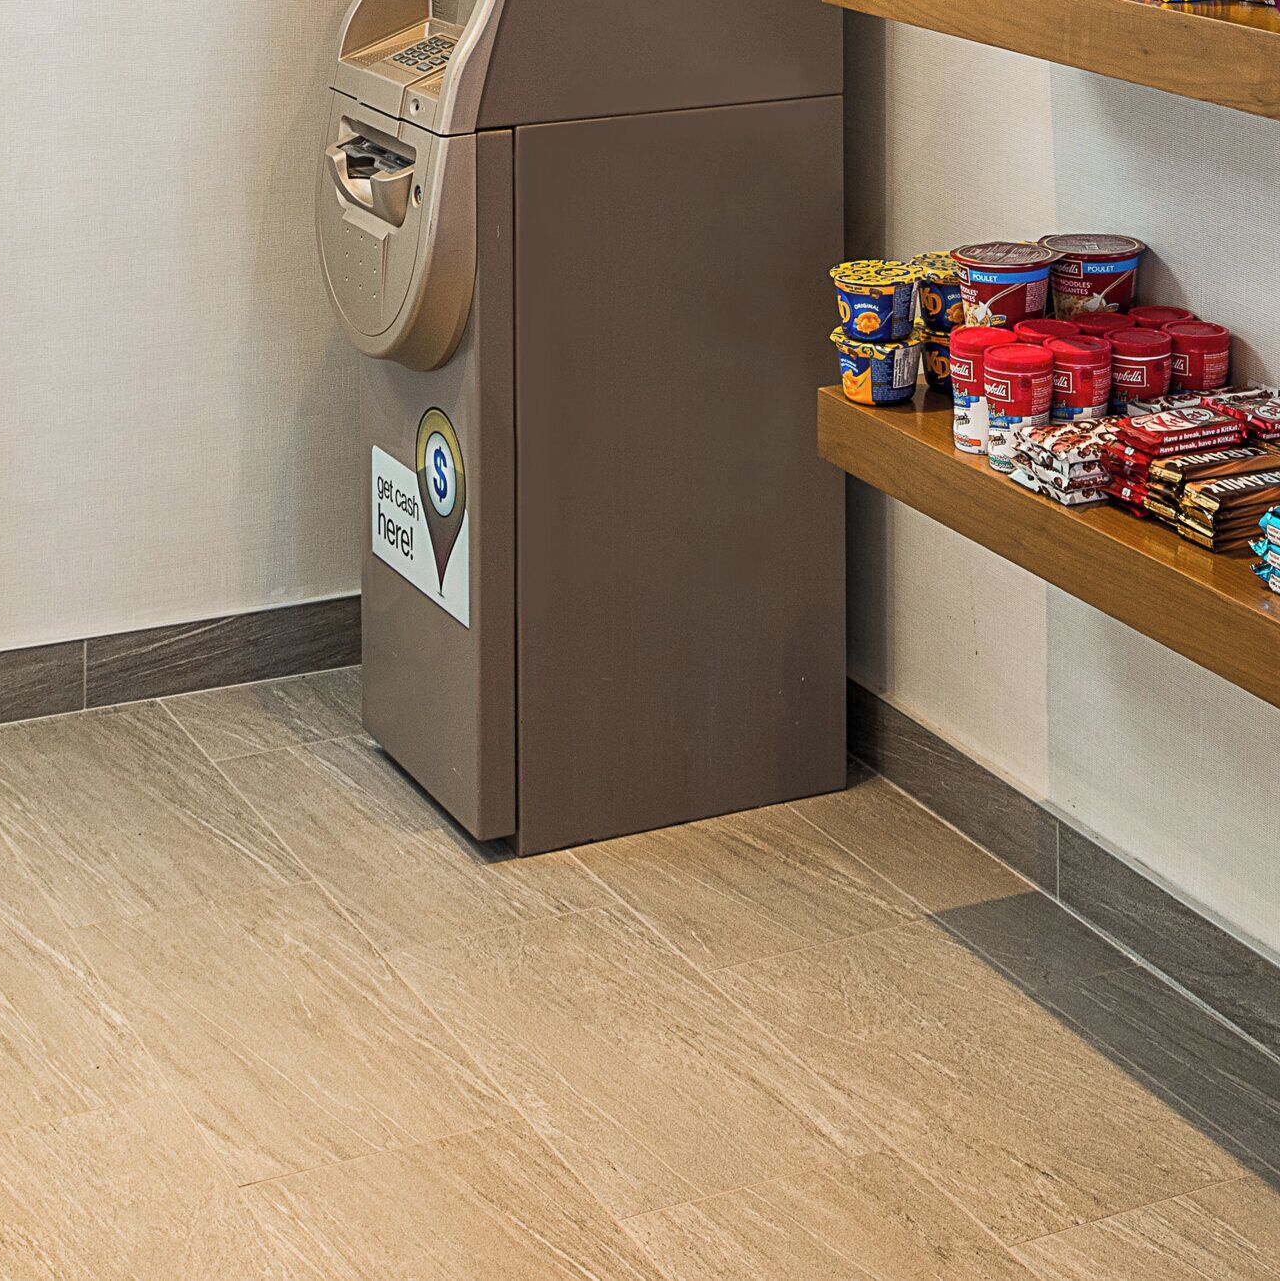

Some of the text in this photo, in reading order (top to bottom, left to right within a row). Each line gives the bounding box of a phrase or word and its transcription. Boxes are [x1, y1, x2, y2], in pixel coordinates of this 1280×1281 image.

[1087, 265, 1115, 273] POULET
[972, 273, 998, 282] POULET
[853, 303, 880, 311] ORIGINAL
[1163, 435, 1178, 443] Have
[1202, 428, 1215, 436] have
[1160, 445, 1174, 454] Have
[1198, 439, 1212, 447] have
[1170, 447, 1268, 468] CARAMILK
[432, 446, 448, 503] $
[377, 476, 419, 521] get cash
[377, 502, 414, 561] here!
